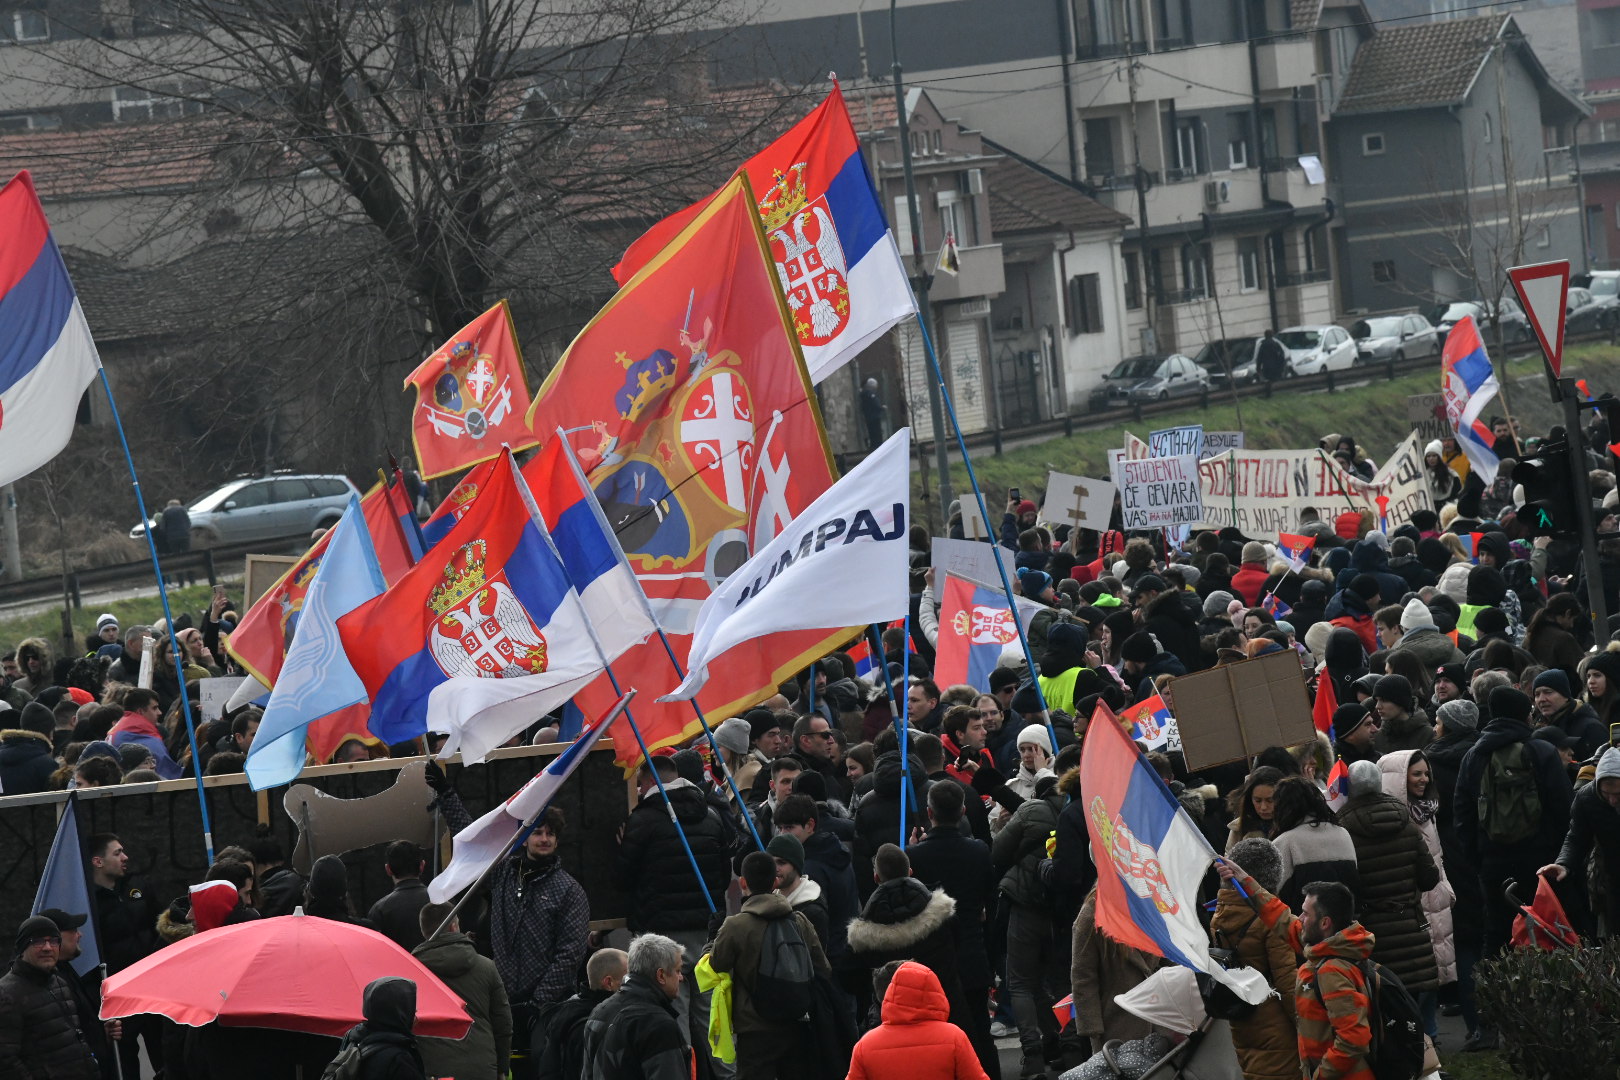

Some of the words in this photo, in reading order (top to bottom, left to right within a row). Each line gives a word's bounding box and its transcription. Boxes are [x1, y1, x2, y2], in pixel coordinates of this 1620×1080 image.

[1200, 434, 1238, 447] АВУШЕ
[1125, 459, 1187, 483] STUDENTI,
[1124, 483, 1140, 508] ČE
[1147, 481, 1199, 507] GEVARA
[1124, 510, 1148, 527] VAS
[1172, 505, 1200, 522] MAJICI
